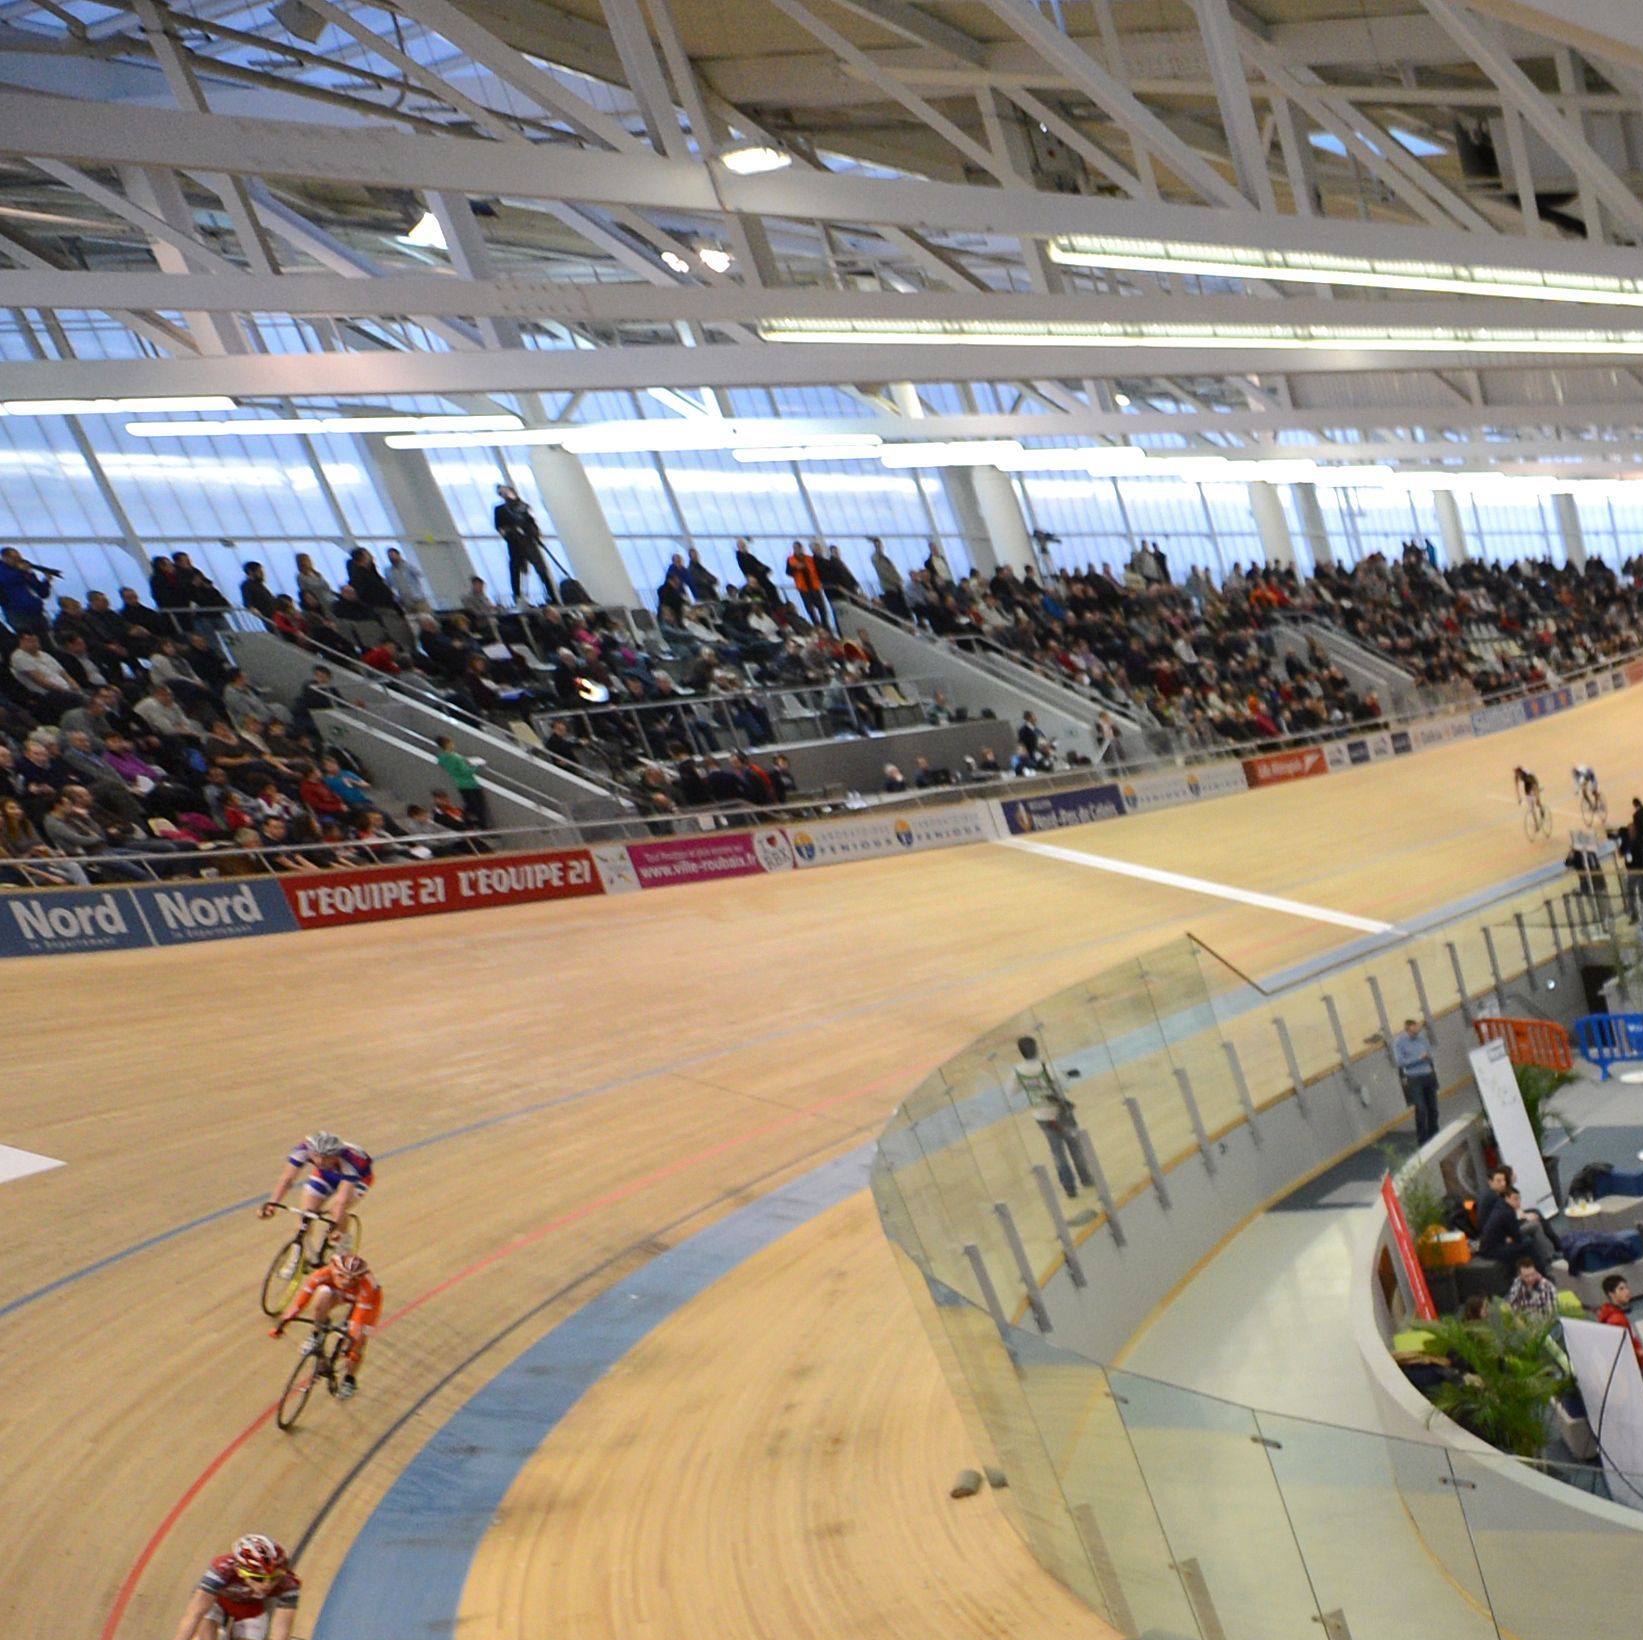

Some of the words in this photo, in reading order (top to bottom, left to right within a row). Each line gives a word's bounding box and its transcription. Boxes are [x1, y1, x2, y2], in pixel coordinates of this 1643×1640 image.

[567, 858, 592, 885] 21
[639, 852, 757, 880] www.ville-roubaix.fr
[418, 877, 447, 905] 21
[8, 893, 129, 940] Nord
[154, 883, 264, 931] Nord
